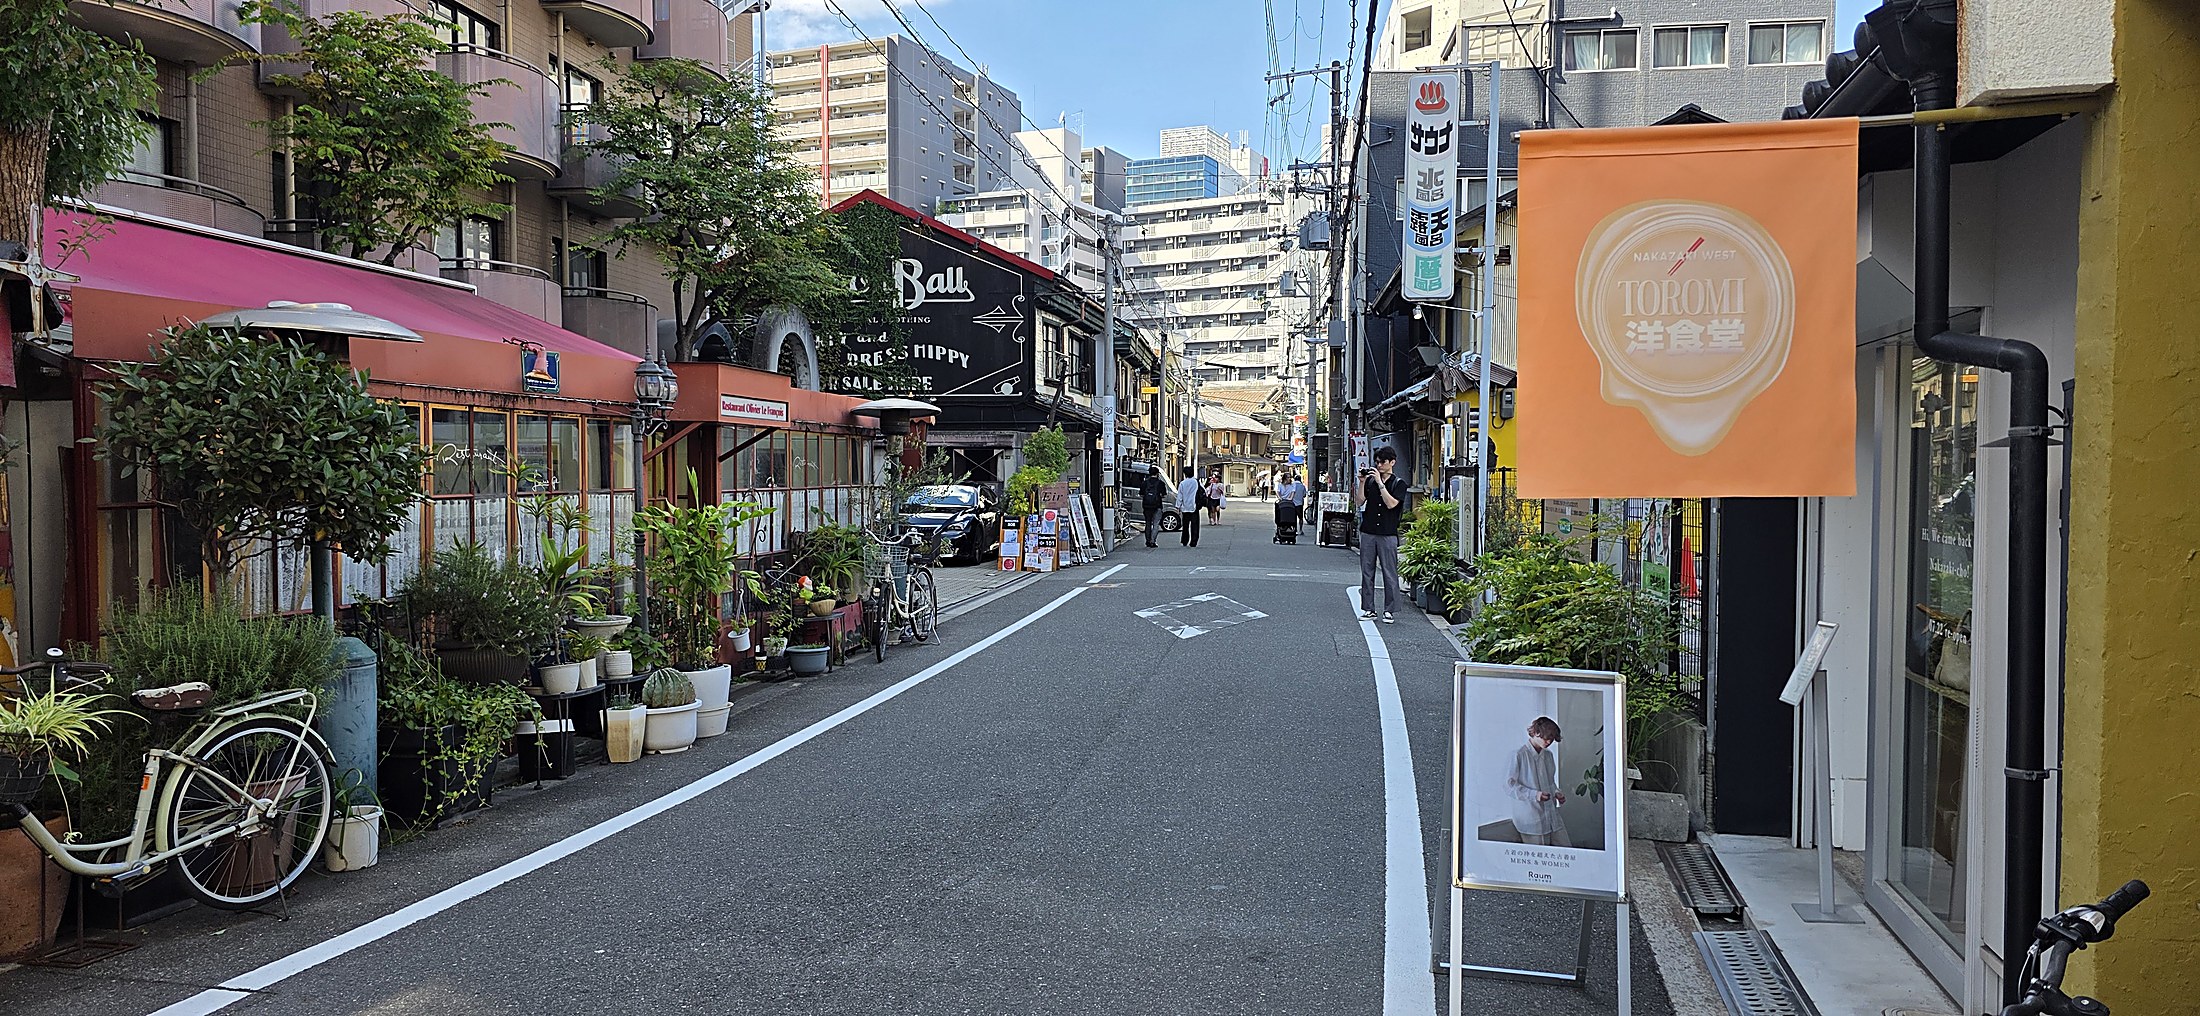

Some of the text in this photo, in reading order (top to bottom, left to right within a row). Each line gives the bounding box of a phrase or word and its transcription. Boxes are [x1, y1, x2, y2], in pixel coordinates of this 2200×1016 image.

[1410, 119, 1453, 155] サウナ
[1633, 250, 1736, 262] NAKAZAKI WEST
[893, 258, 973, 310] Ball
[1617, 277, 1747, 317] TOROMI
[1625, 318, 1745, 356] 洋食堂
[847, 344, 970, 369] DRESS HIPPY
[722, 400, 745, 412] Restaurant
[745, 403, 761, 414] Olivier
[761, 405, 767, 415] Le
[434, 443, 506, 466] Resturant
[1931, 529, 1940, 543] We
[1941, 533, 1956, 546] came
[1957, 532, 1972, 548] back
[1510, 857, 1532, 865] MENS
[1541, 860, 1570, 868] WOMEN
[1528, 871, 1552, 879] Raum
